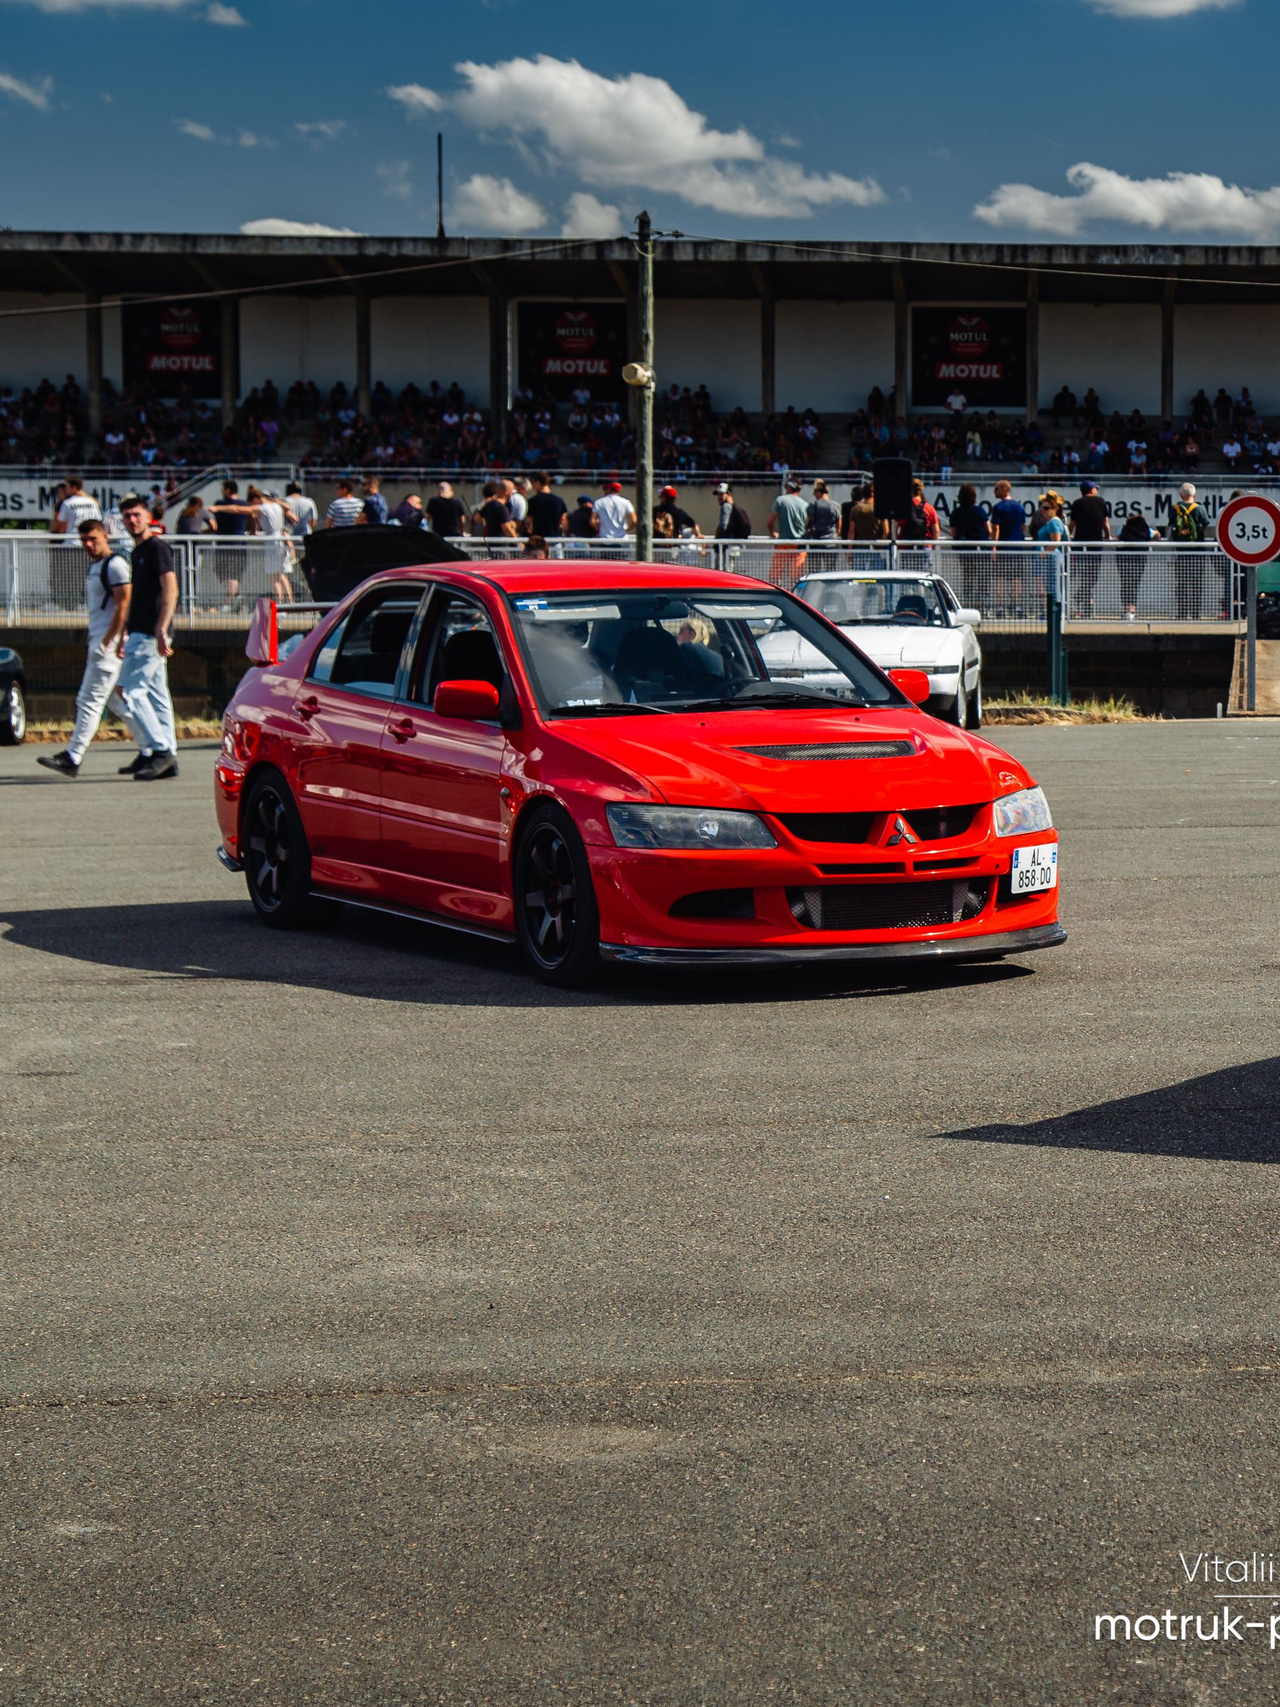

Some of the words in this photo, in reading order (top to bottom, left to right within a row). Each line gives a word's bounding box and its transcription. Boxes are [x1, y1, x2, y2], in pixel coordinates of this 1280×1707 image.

[556, 327, 596, 337] MOTUL
[949, 332, 989, 341] MOTUL
[151, 355, 213, 370] MOTUL
[545, 359, 608, 374] MOTUL
[939, 364, 1002, 378] MOTUL
[1235, 522, 1269, 542] 3,5t
